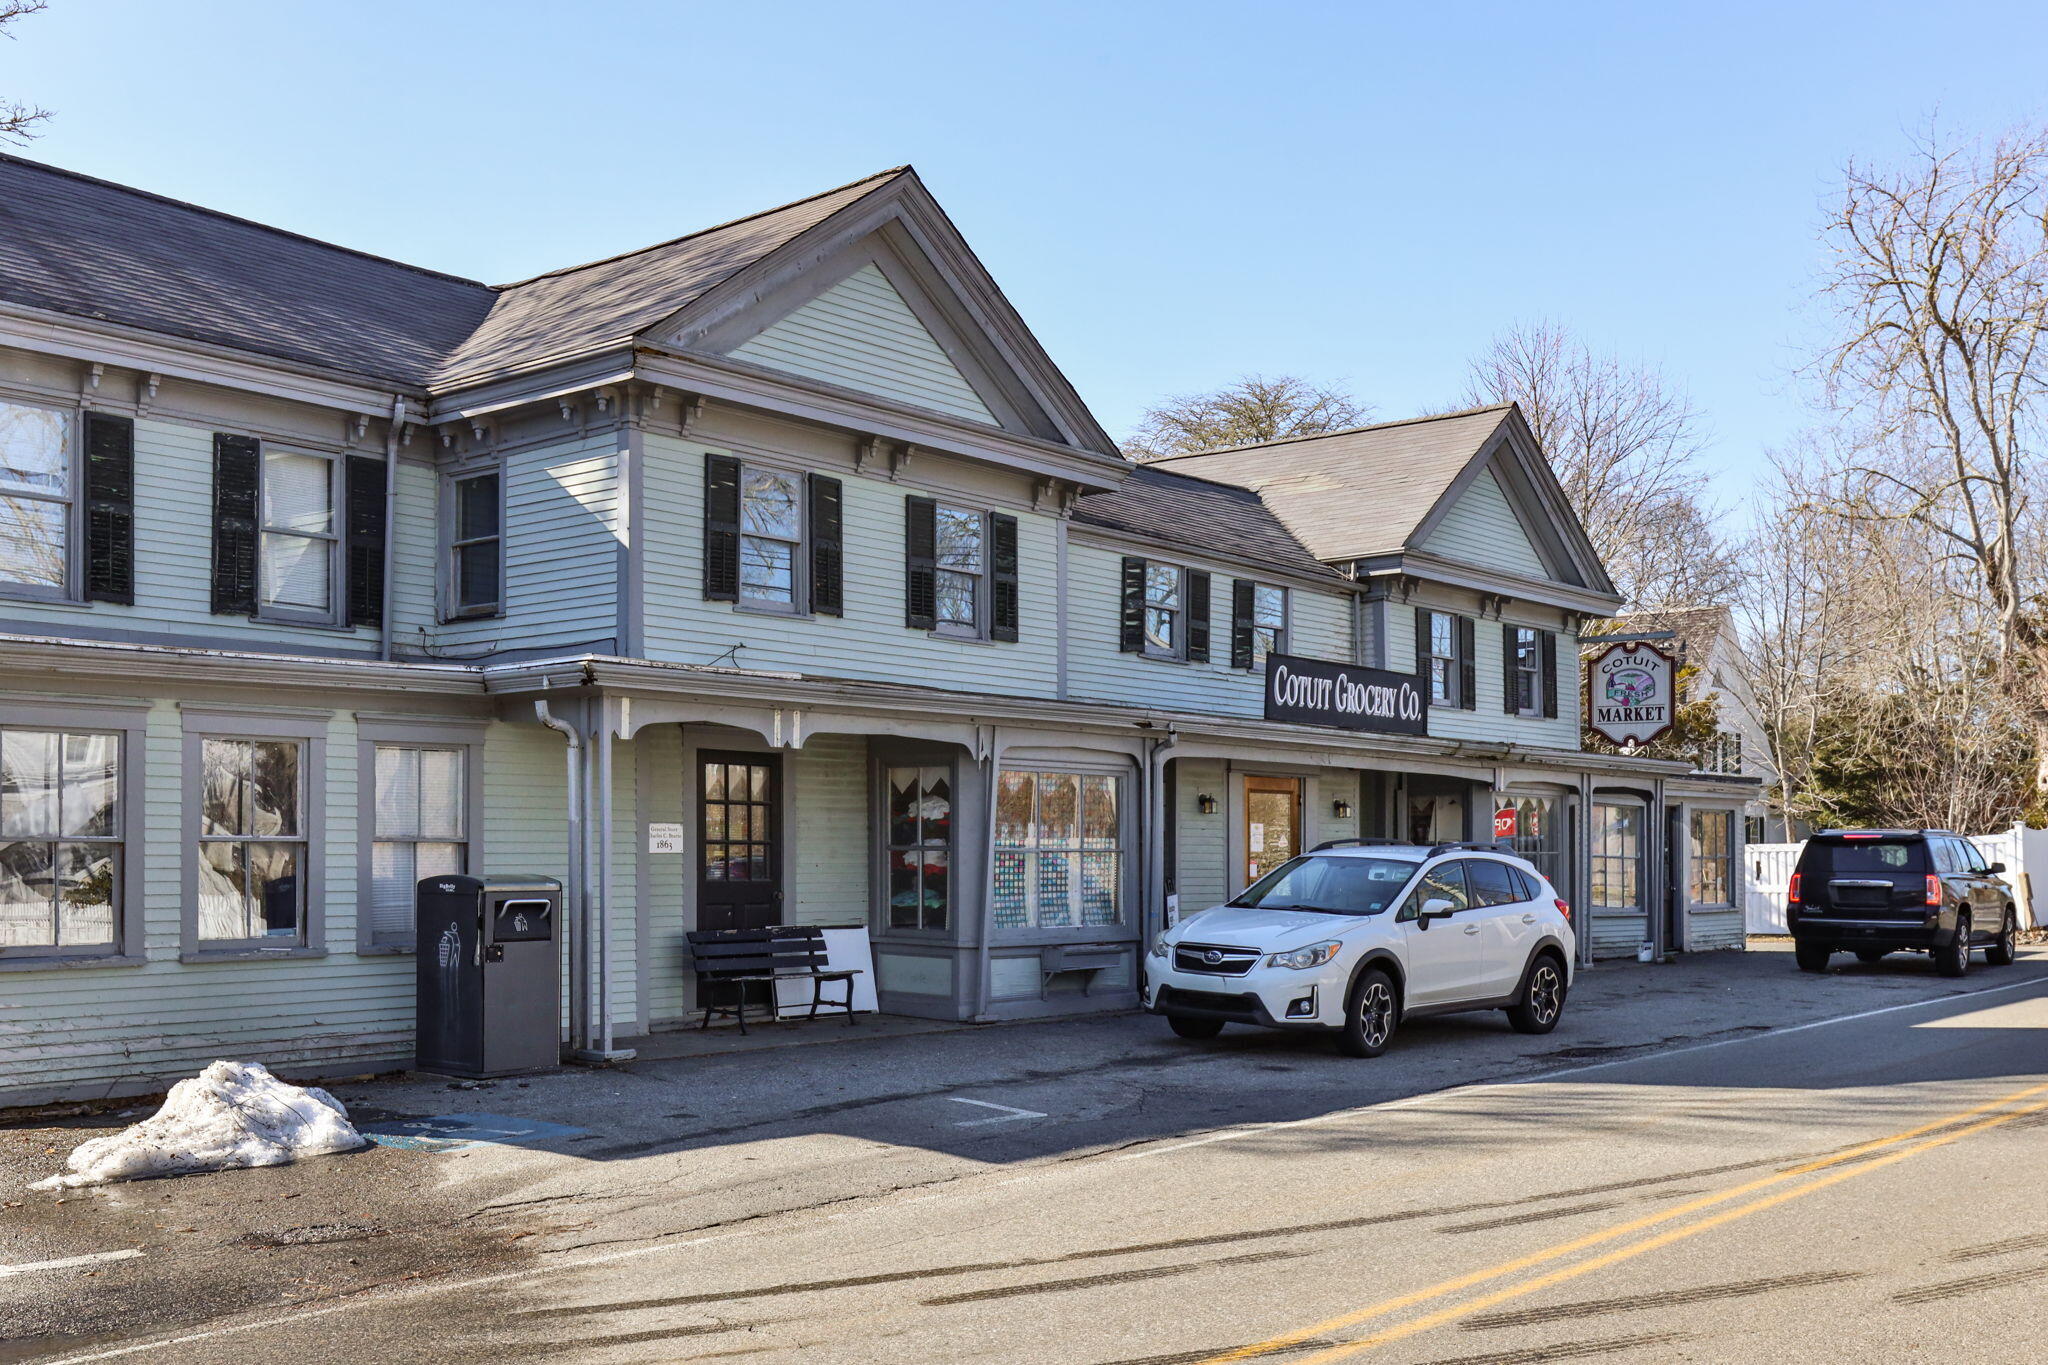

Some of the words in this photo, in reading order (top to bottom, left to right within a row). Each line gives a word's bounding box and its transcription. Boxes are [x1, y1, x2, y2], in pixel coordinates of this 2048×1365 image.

[1602, 656, 1661, 674] COTUIT
[1614, 688, 1648, 698] FRESH
[1597, 706, 1665, 723] MARKET
[656, 839, 673, 851] 1863
